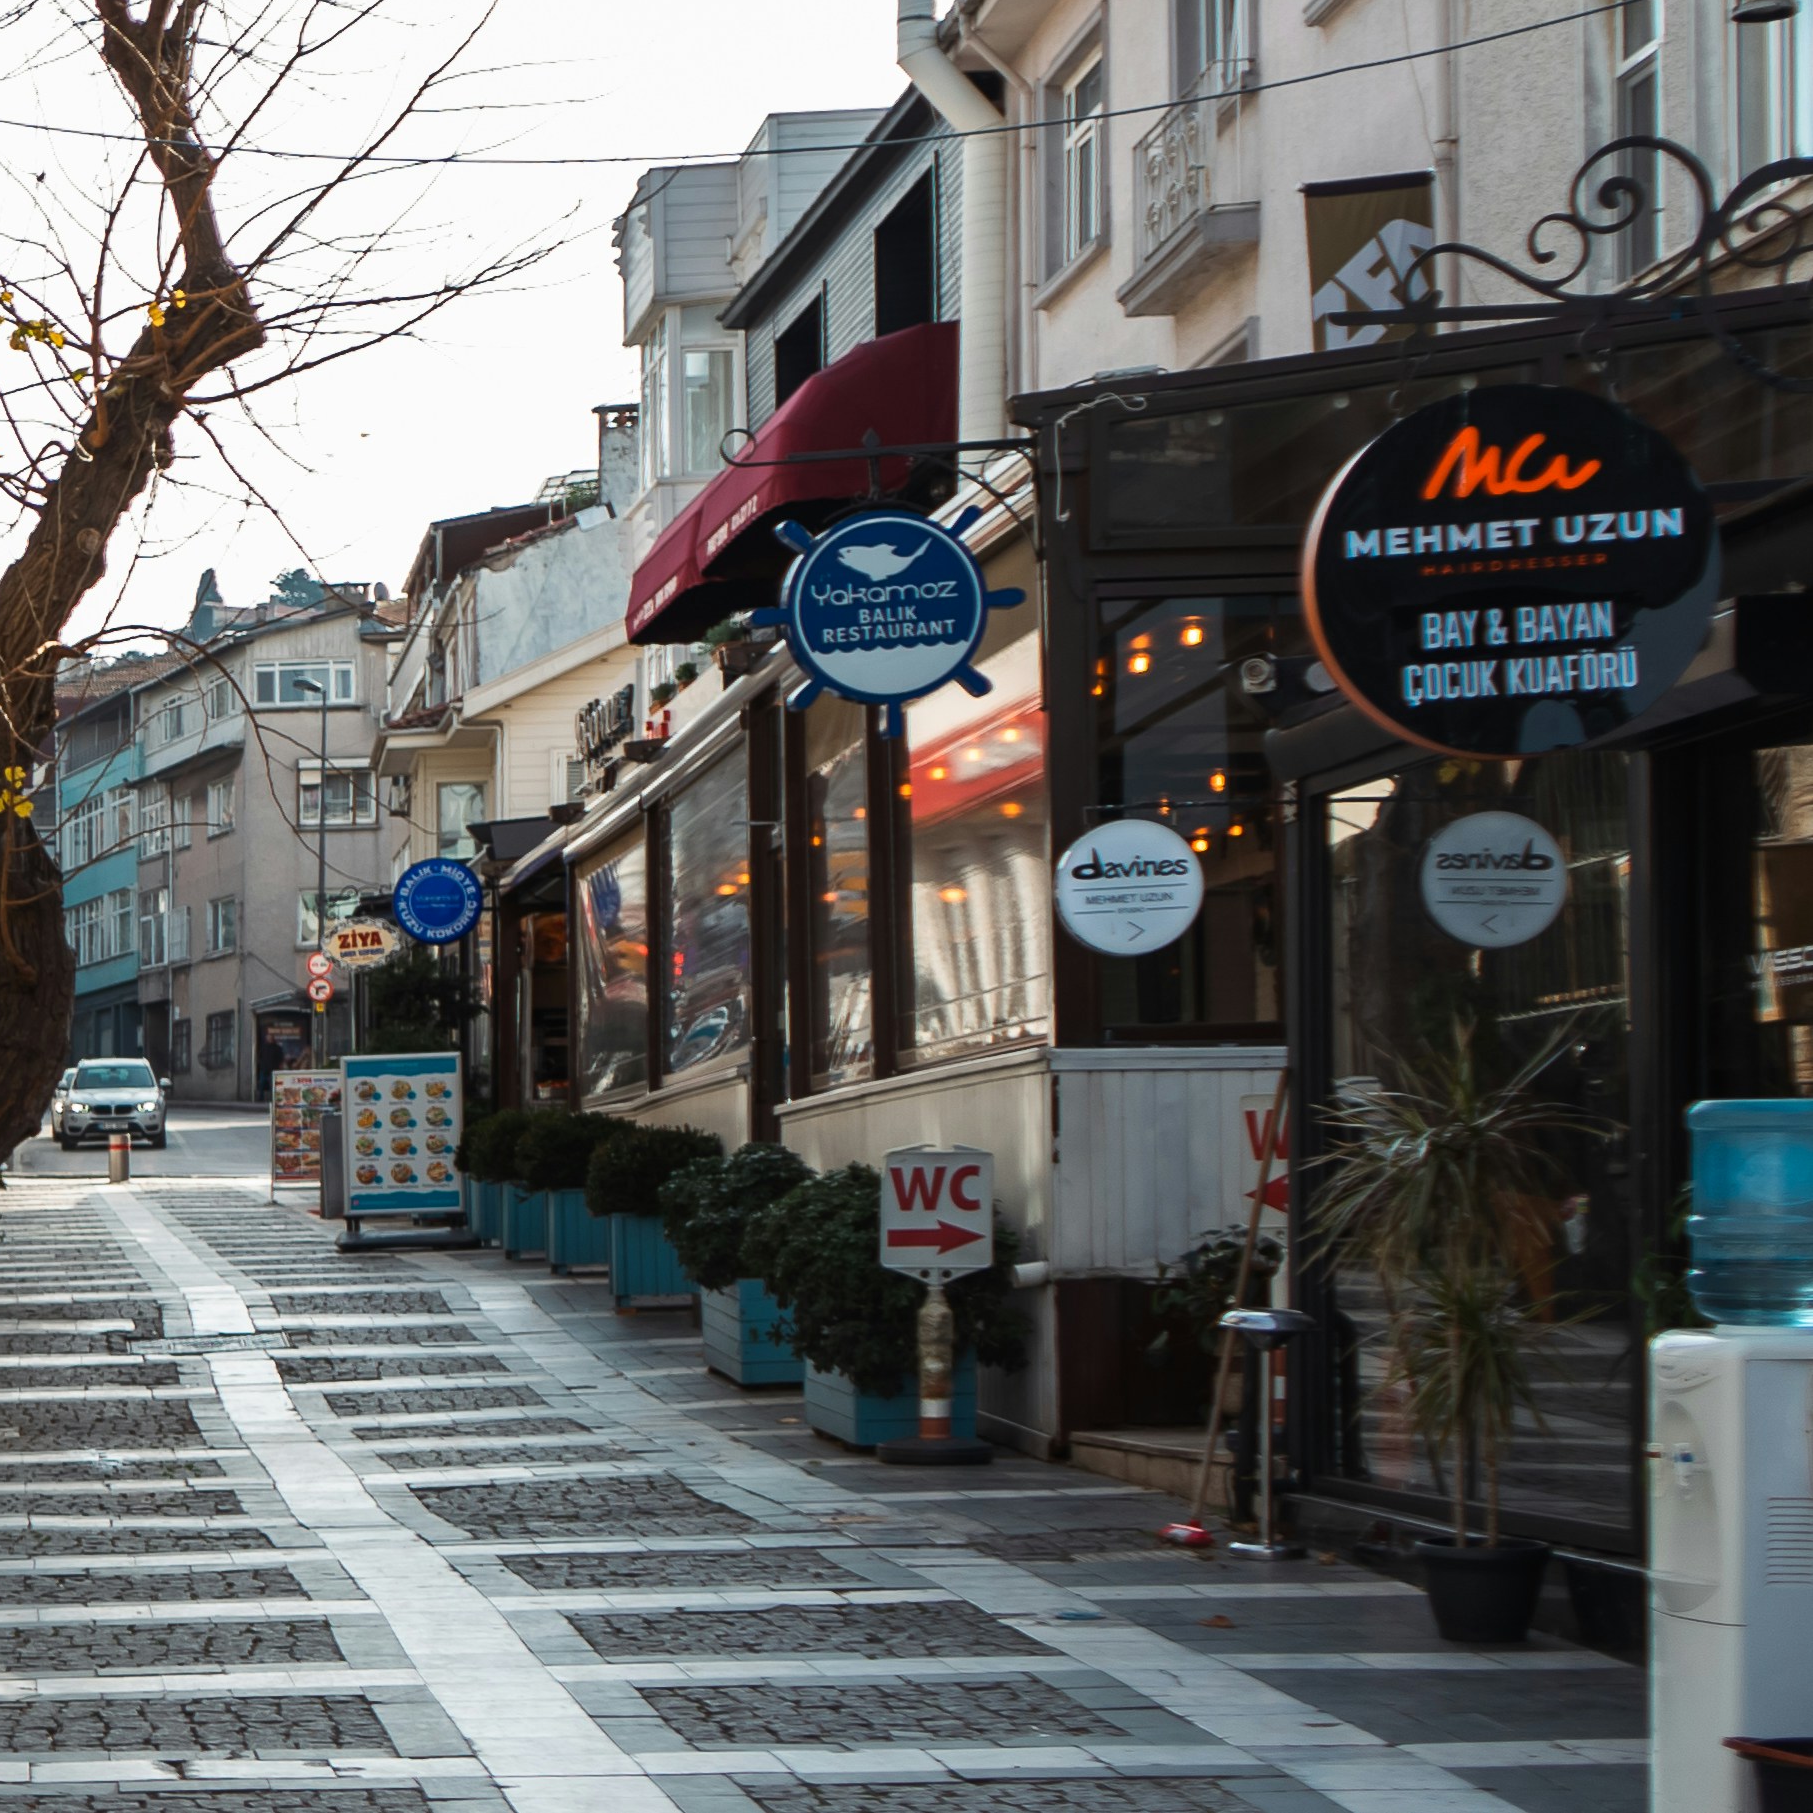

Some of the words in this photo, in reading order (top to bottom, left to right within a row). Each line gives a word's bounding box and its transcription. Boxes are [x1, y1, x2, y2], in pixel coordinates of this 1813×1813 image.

[1344, 518, 1541, 559] MEHMET
[1553, 508, 1684, 544] UZUN
[1420, 553, 1608, 576] HAIRDRESSER
[811, 581, 958, 606] Yakamoz
[859, 606, 917, 624] BALIK
[1420, 610, 1479, 650] BAY
[1485, 608, 1508, 645] &
[1515, 601, 1614, 643] BAYAN
[822, 619, 956, 643] RESTAURANT
[1402, 658, 1498, 706] ÇOCUK
[1506, 646, 1638, 697] KUAFÖRÜ
[1072, 847, 1188, 880] davines
[1085, 893, 1136, 905] MEHMET
[1140, 891, 1174, 903] UZUN
[338, 929, 382, 949] ZİYA
[890, 1164, 981, 1212] WC
